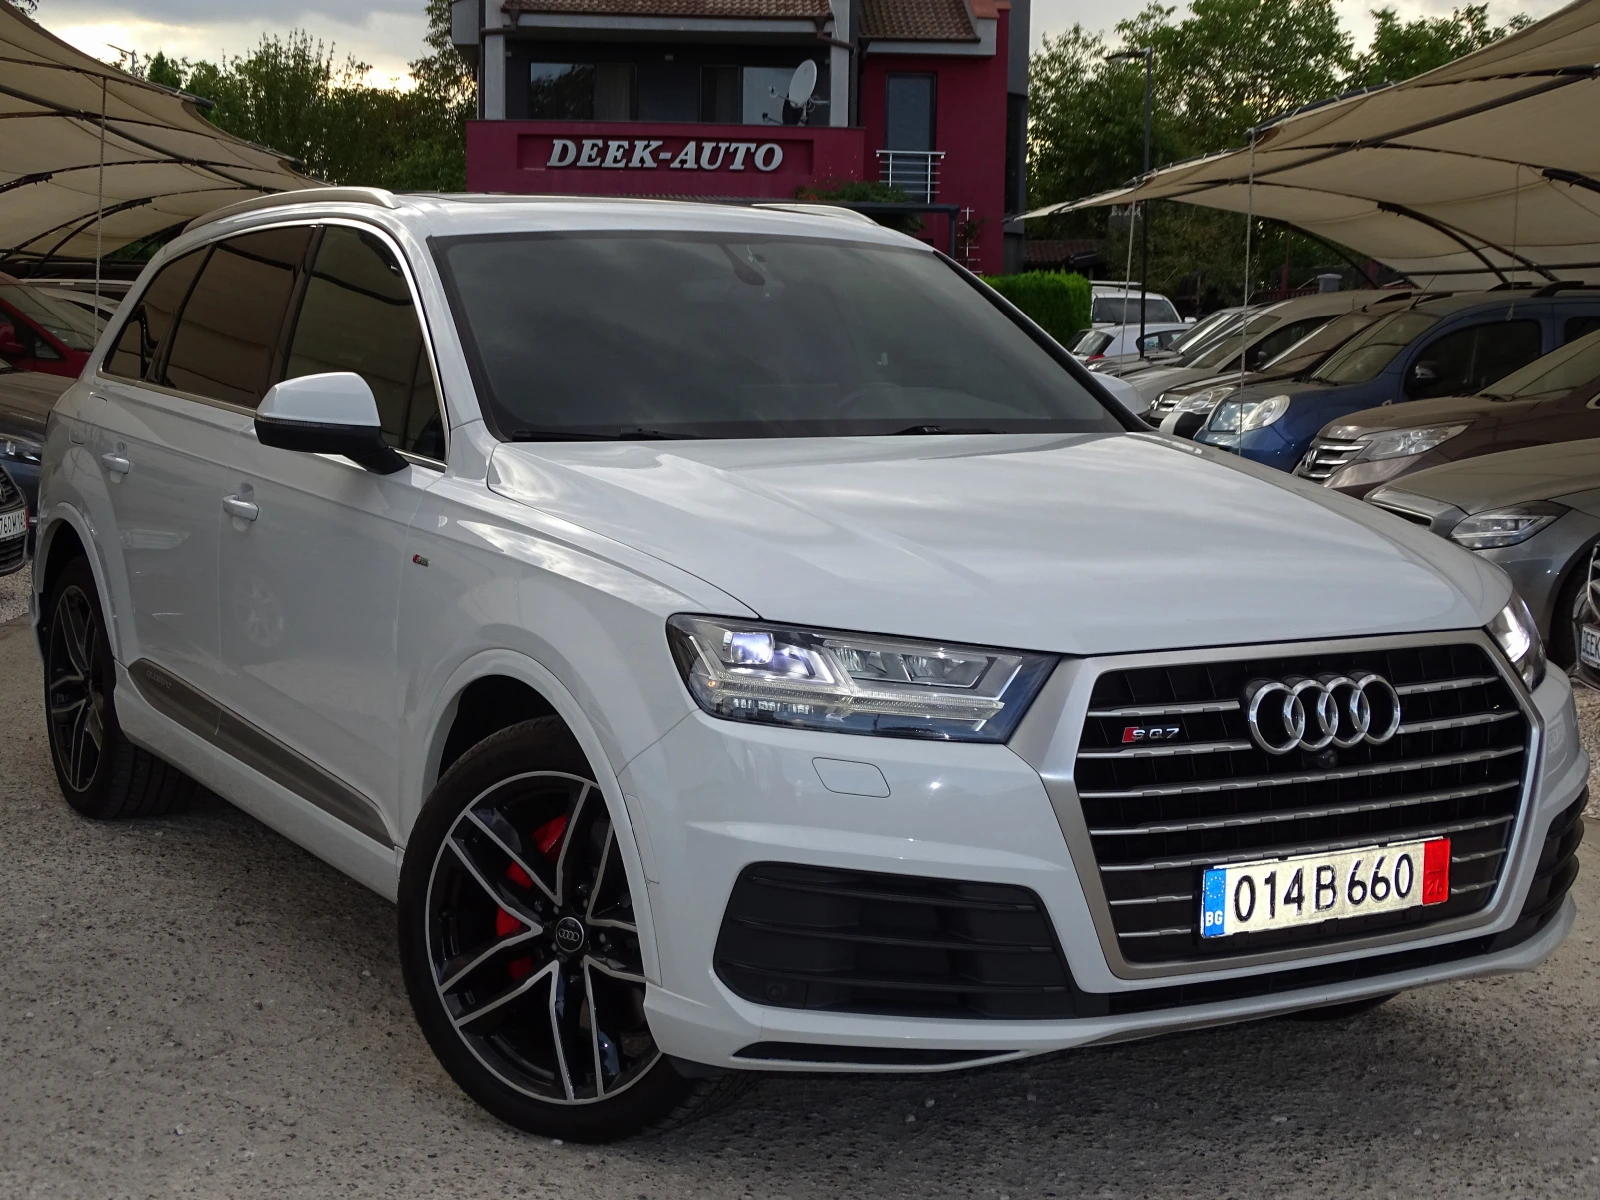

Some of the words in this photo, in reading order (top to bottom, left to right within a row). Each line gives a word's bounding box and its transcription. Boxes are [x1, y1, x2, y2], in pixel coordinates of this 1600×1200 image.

[547, 139, 783, 171] DEEK-AUTO
[1131, 727, 1180, 740] SQ7
[1205, 910, 1224, 927] BG
